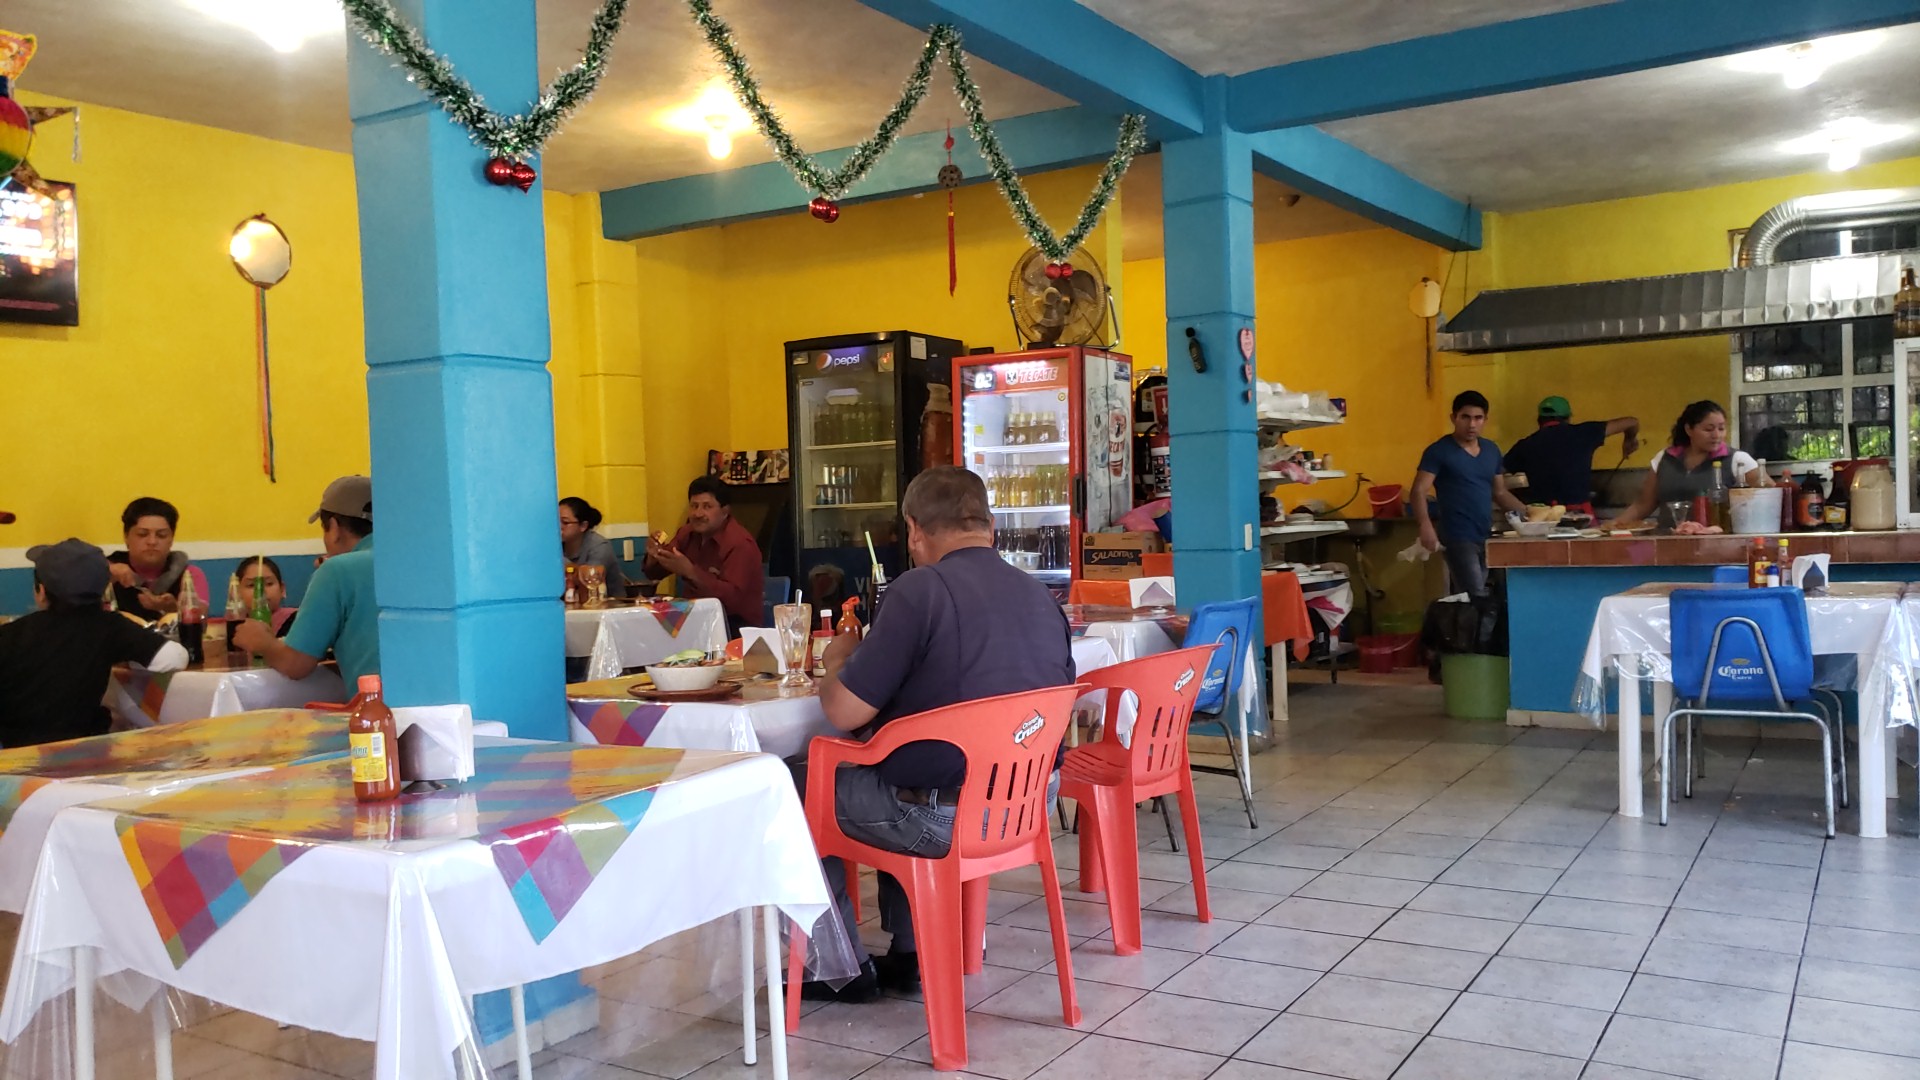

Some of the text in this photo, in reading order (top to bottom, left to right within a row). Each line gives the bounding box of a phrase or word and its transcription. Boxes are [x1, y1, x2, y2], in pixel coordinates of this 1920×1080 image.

[834, 353, 860, 367] pepsi
[1018, 366, 1058, 383] TECATE
[1091, 550, 1134, 563] SALADITAS
[1718, 665, 1764, 677] Corona
